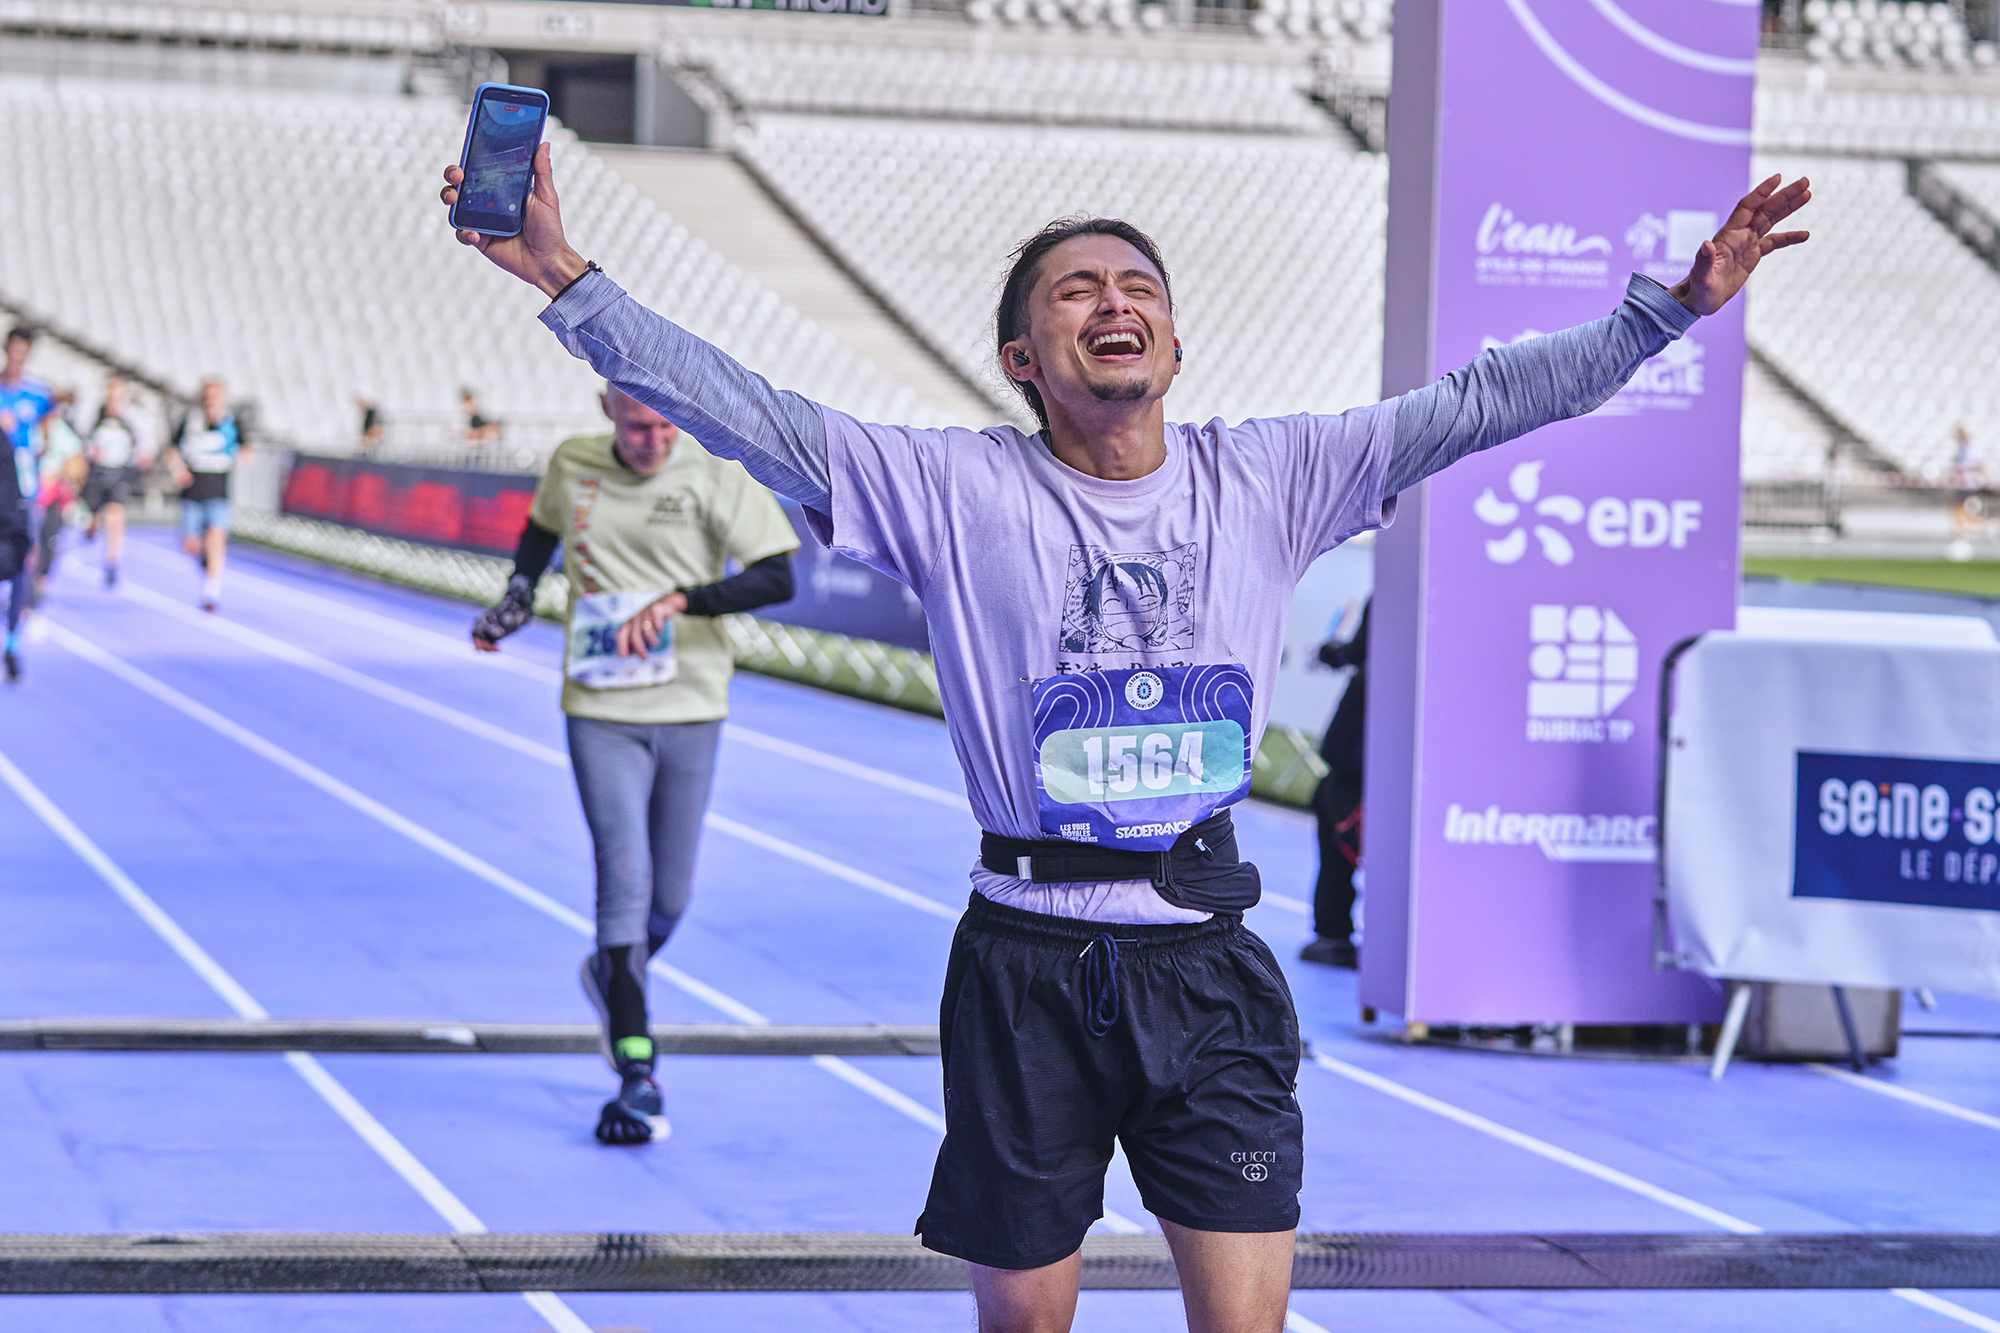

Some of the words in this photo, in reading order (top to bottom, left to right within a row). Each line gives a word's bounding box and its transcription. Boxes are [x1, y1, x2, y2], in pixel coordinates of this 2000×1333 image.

[1083, 731, 1204, 795] 1564
[1060, 823, 1072, 831] LES
[1071, 822, 1091, 831] VOIES
[1115, 820, 1192, 839] STADEFRANCE
[1900, 847, 1932, 881] LE
[1230, 1151, 1276, 1163] GUCCI
